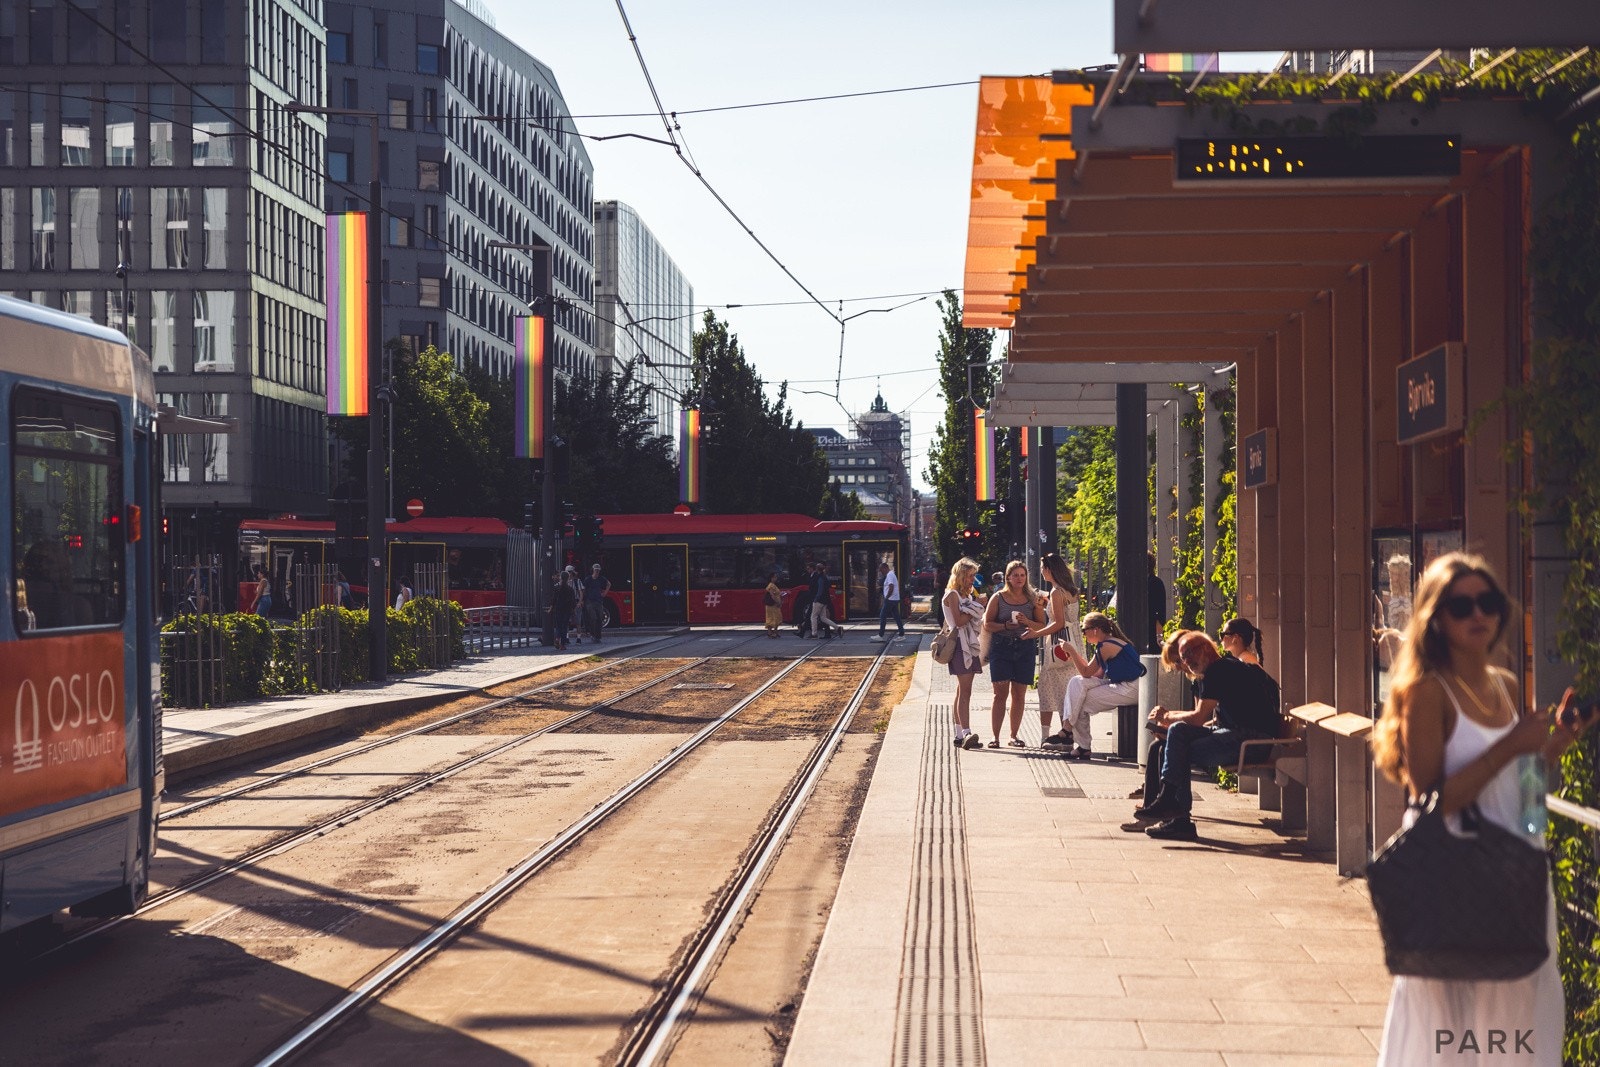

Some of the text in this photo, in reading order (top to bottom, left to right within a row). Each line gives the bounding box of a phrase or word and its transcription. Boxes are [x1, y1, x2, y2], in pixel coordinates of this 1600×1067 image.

[818, 435, 873, 447] Østladet
[47, 669, 115, 732] OSLO
[47, 730, 116, 766] FASHION OUTLET
